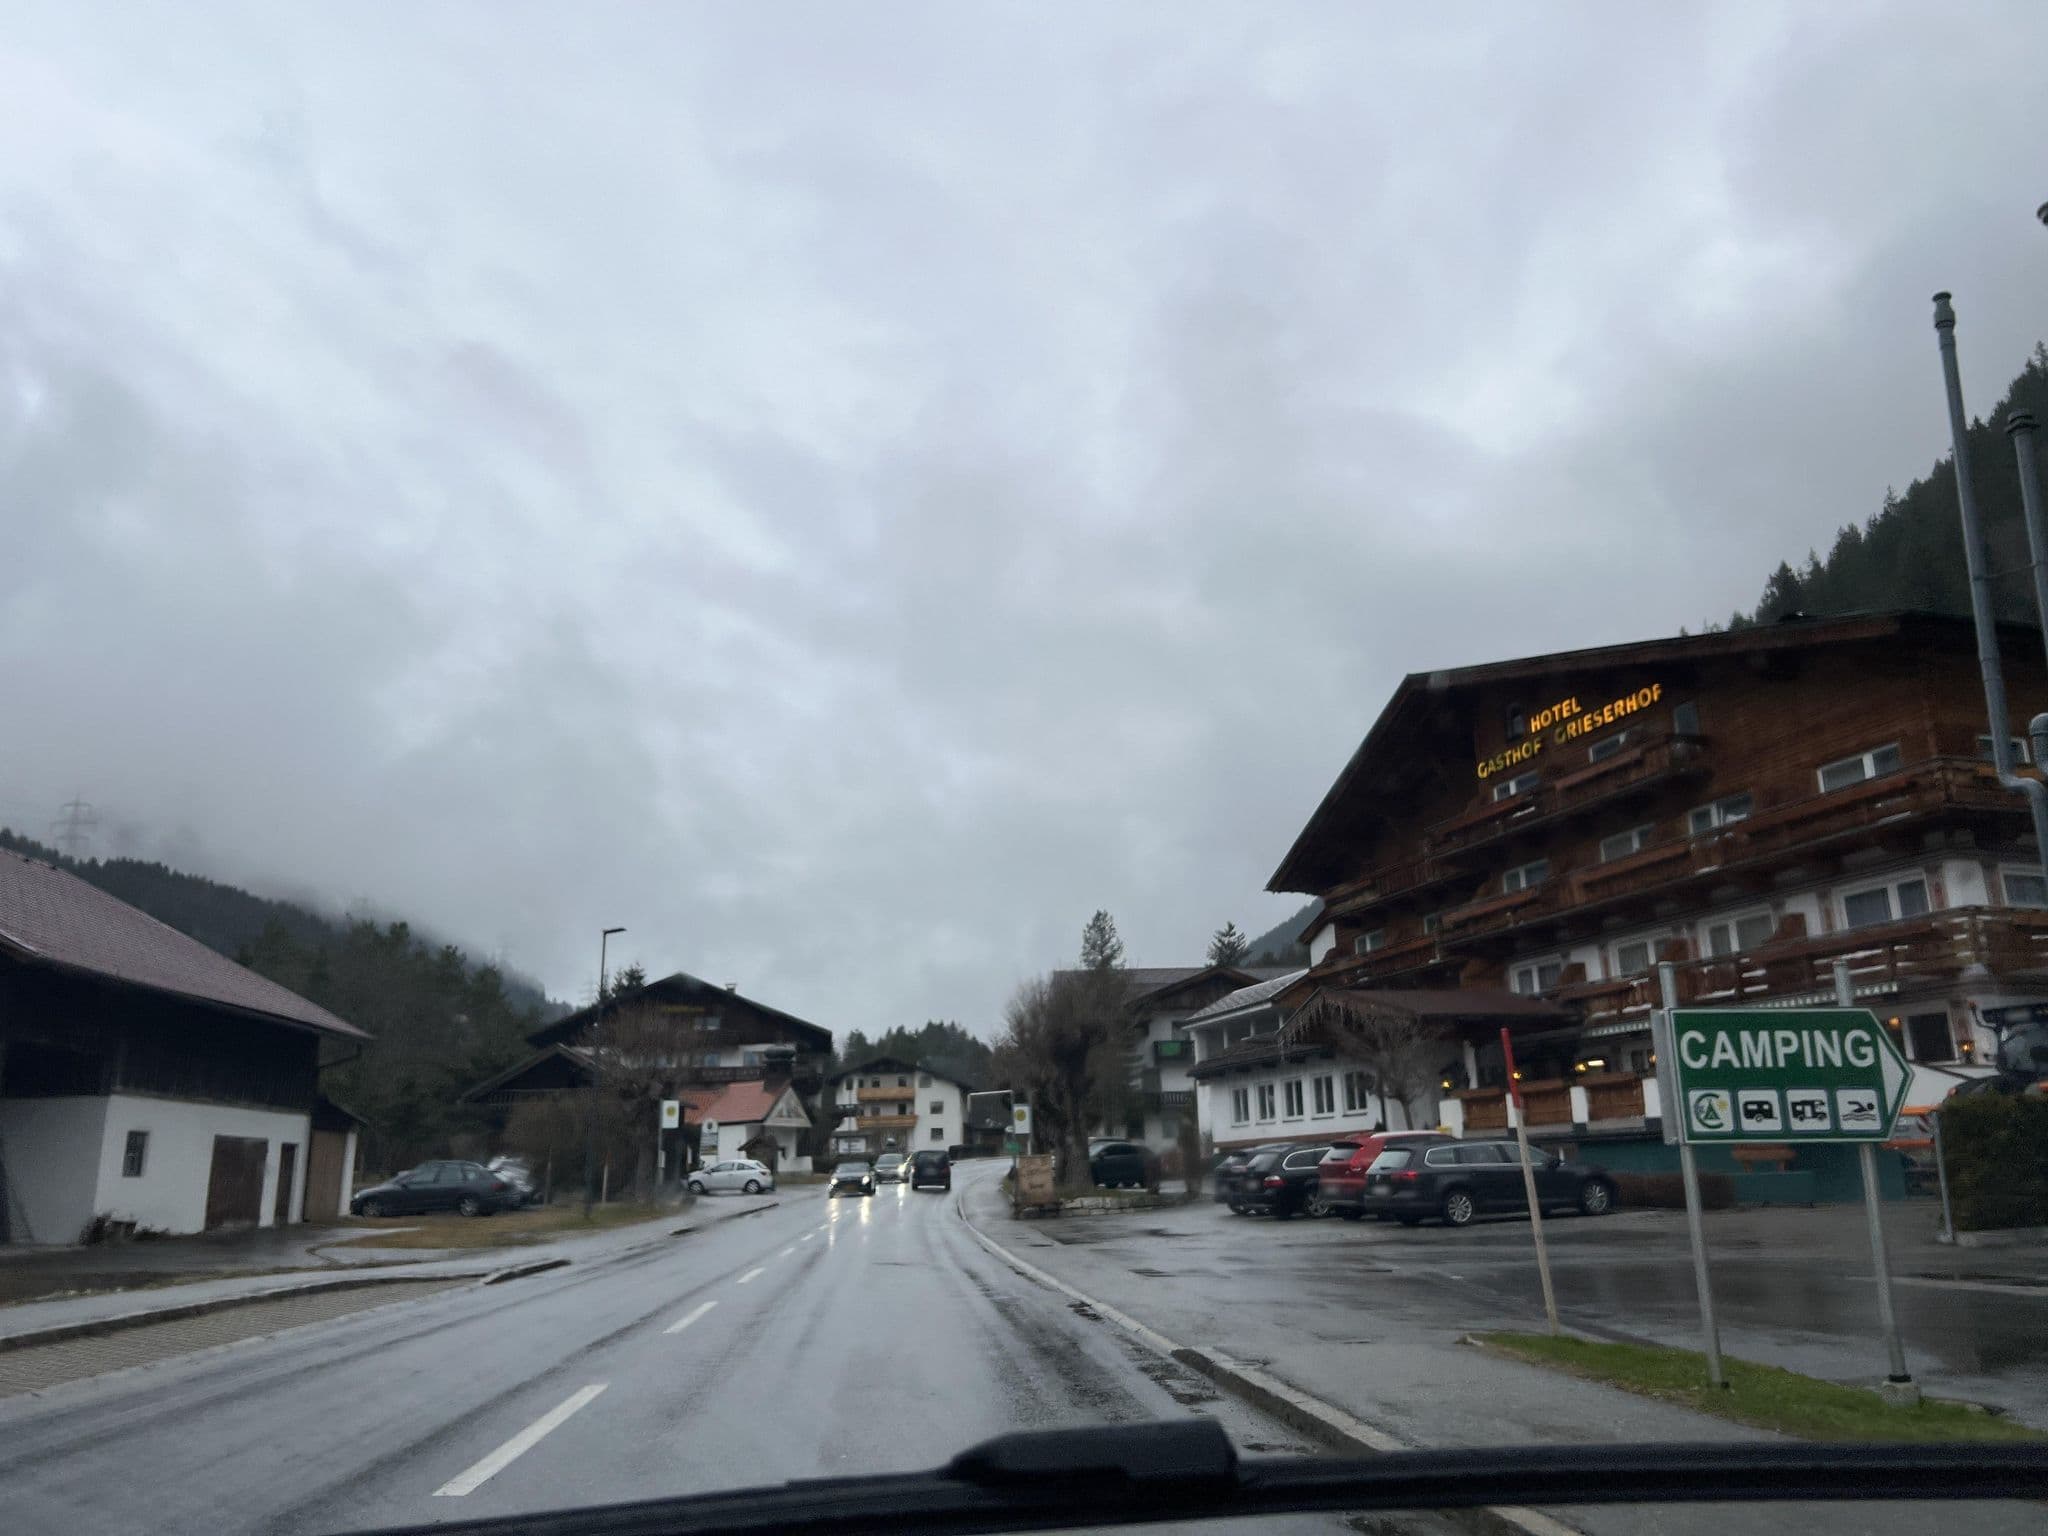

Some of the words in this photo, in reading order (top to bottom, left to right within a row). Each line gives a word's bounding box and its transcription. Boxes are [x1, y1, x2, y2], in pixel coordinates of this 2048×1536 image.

[1477, 739, 1542, 779] GASTHOF
[1554, 683, 1662, 745] GRIESERHOF
[1530, 696, 1582, 733] HOTEL
[1680, 1029, 1875, 1069] CAMPING
